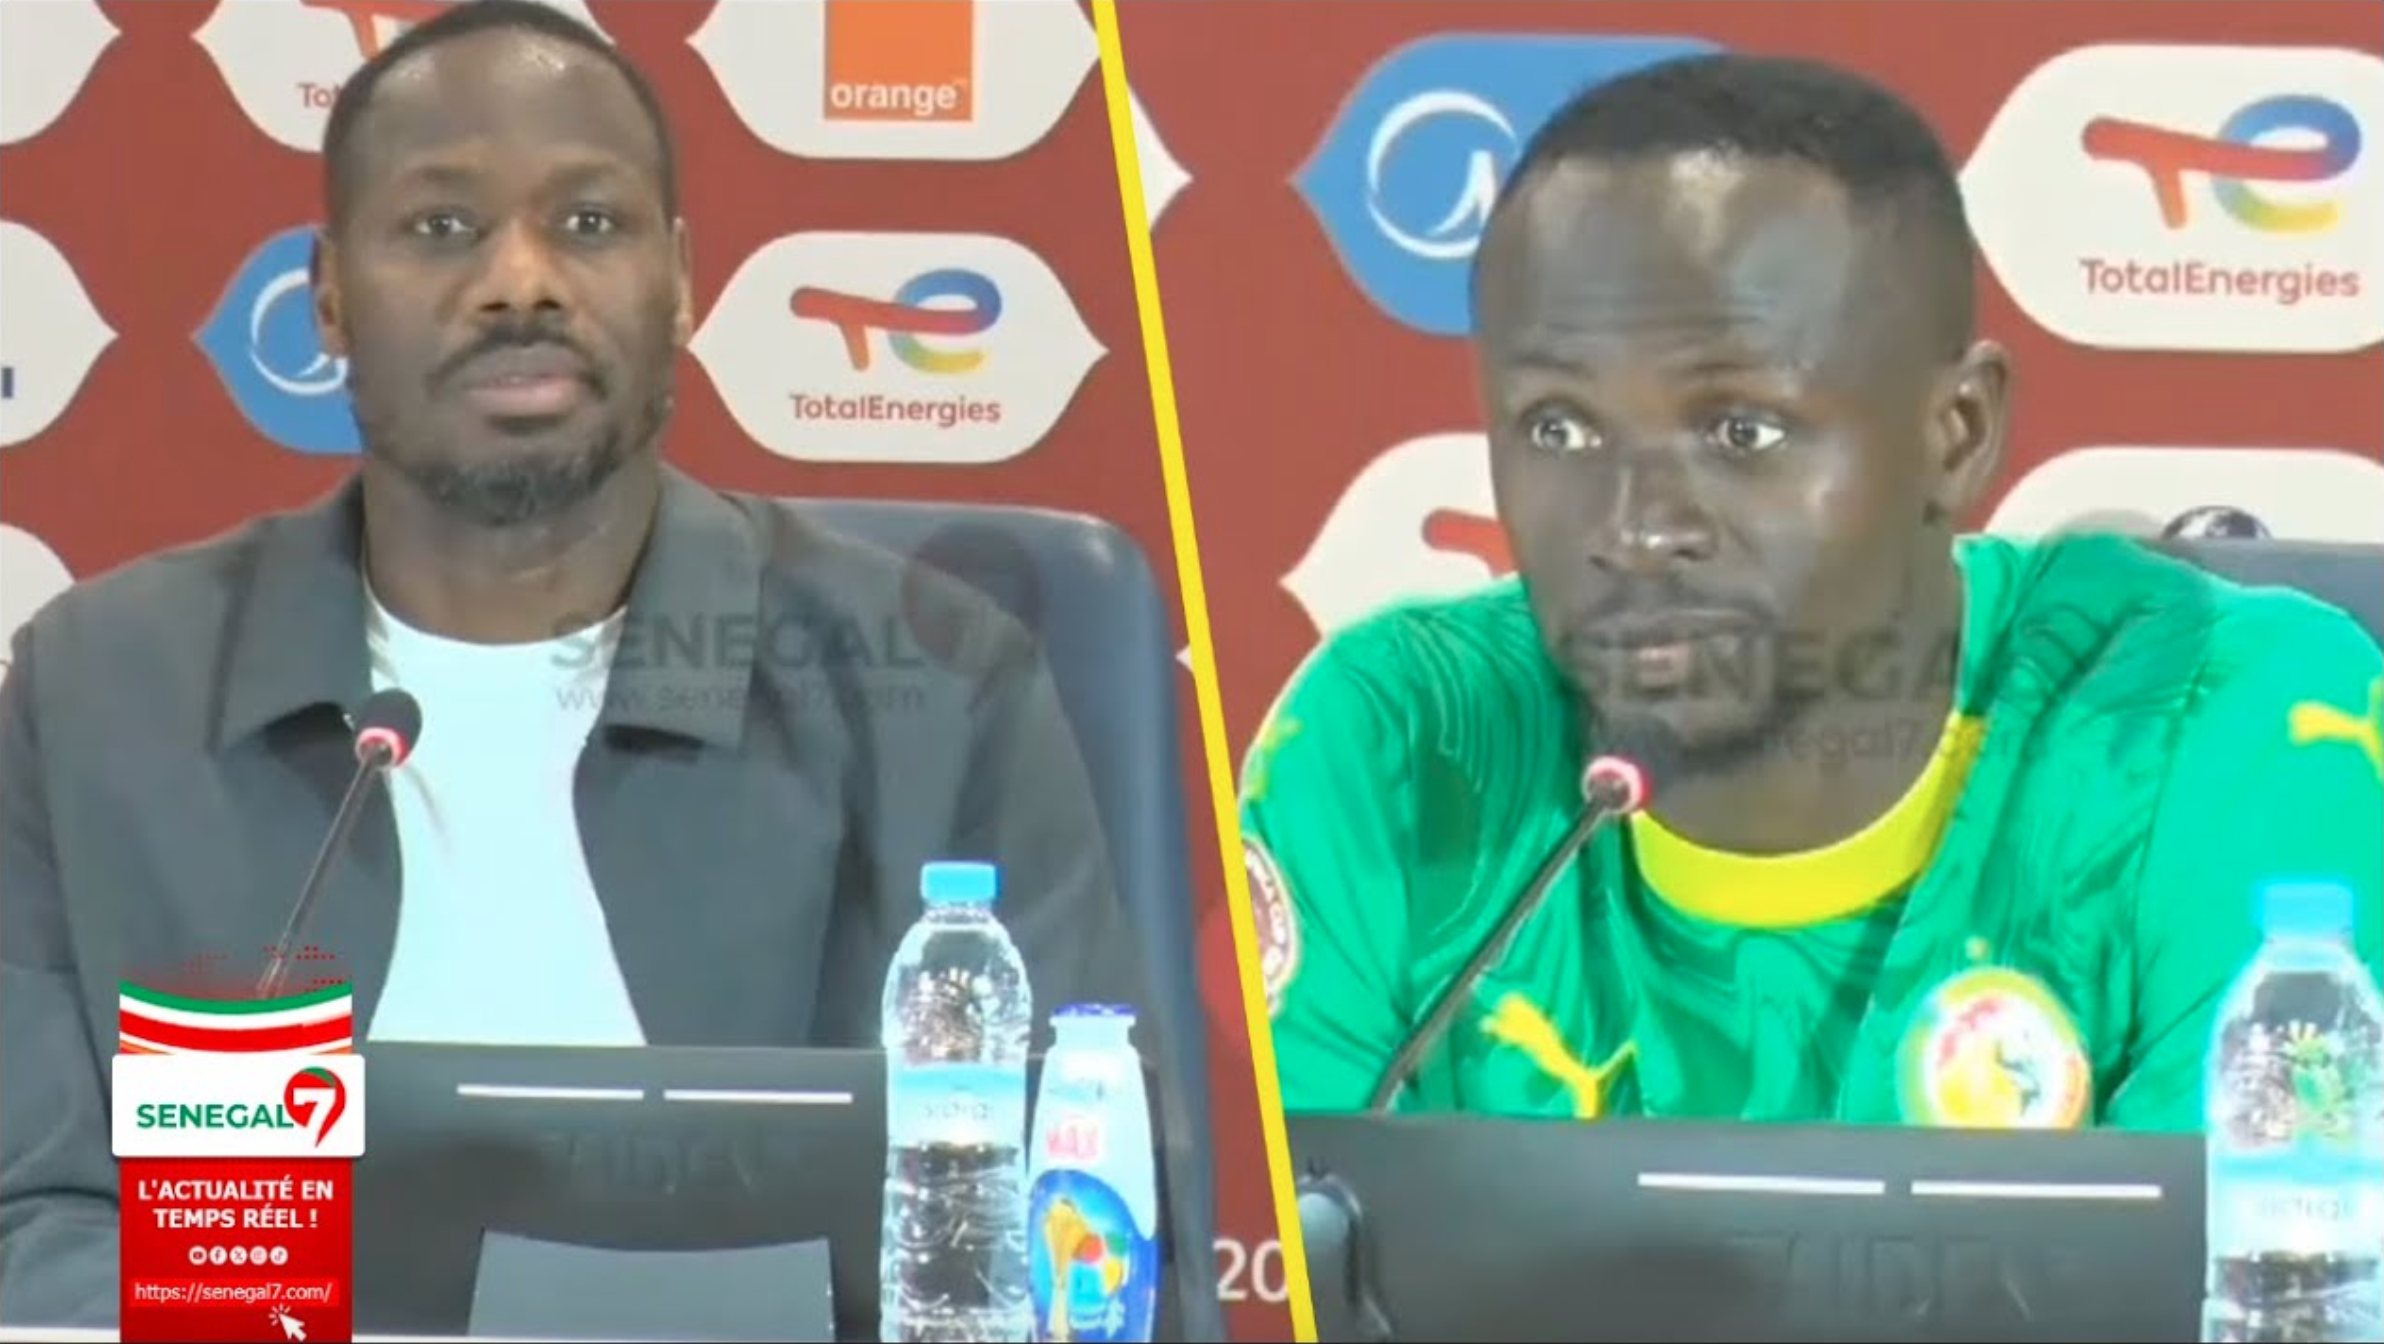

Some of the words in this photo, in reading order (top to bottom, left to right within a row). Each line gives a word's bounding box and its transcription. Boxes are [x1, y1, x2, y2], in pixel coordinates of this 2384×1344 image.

[830, 82, 958, 117] orange
[2079, 259, 2361, 305] TotalEnergies
[789, 394, 1001, 428] TotalEnergies
